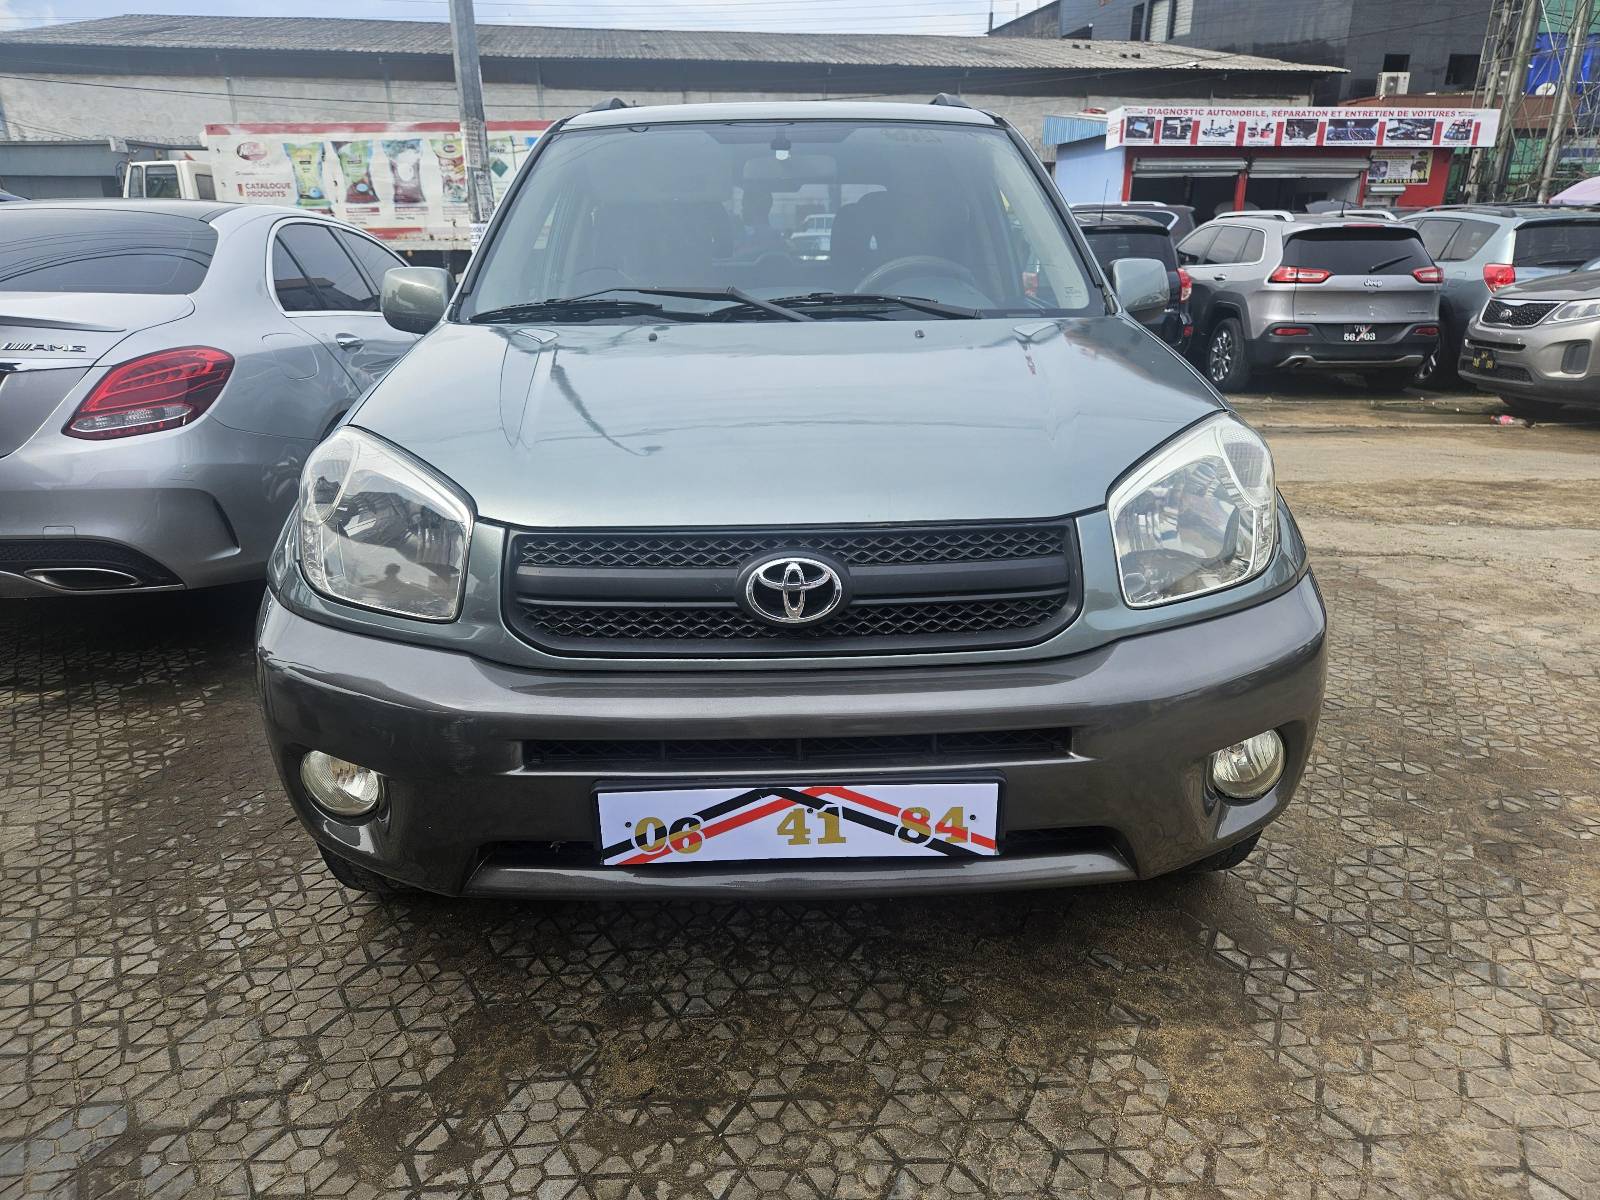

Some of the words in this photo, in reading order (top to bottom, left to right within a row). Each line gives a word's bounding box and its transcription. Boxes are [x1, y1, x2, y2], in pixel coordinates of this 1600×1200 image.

[1147, 108, 1204, 116] DIAGNOSTIC
[1207, 109, 1268, 118] AUTOMOBILE,
[1272, 108, 1328, 117] RÉPARATION
[1364, 279, 1383, 288] Jeep
[633, 815, 704, 854] 06
[776, 805, 847, 846] 41
[897, 806, 969, 843] 84
